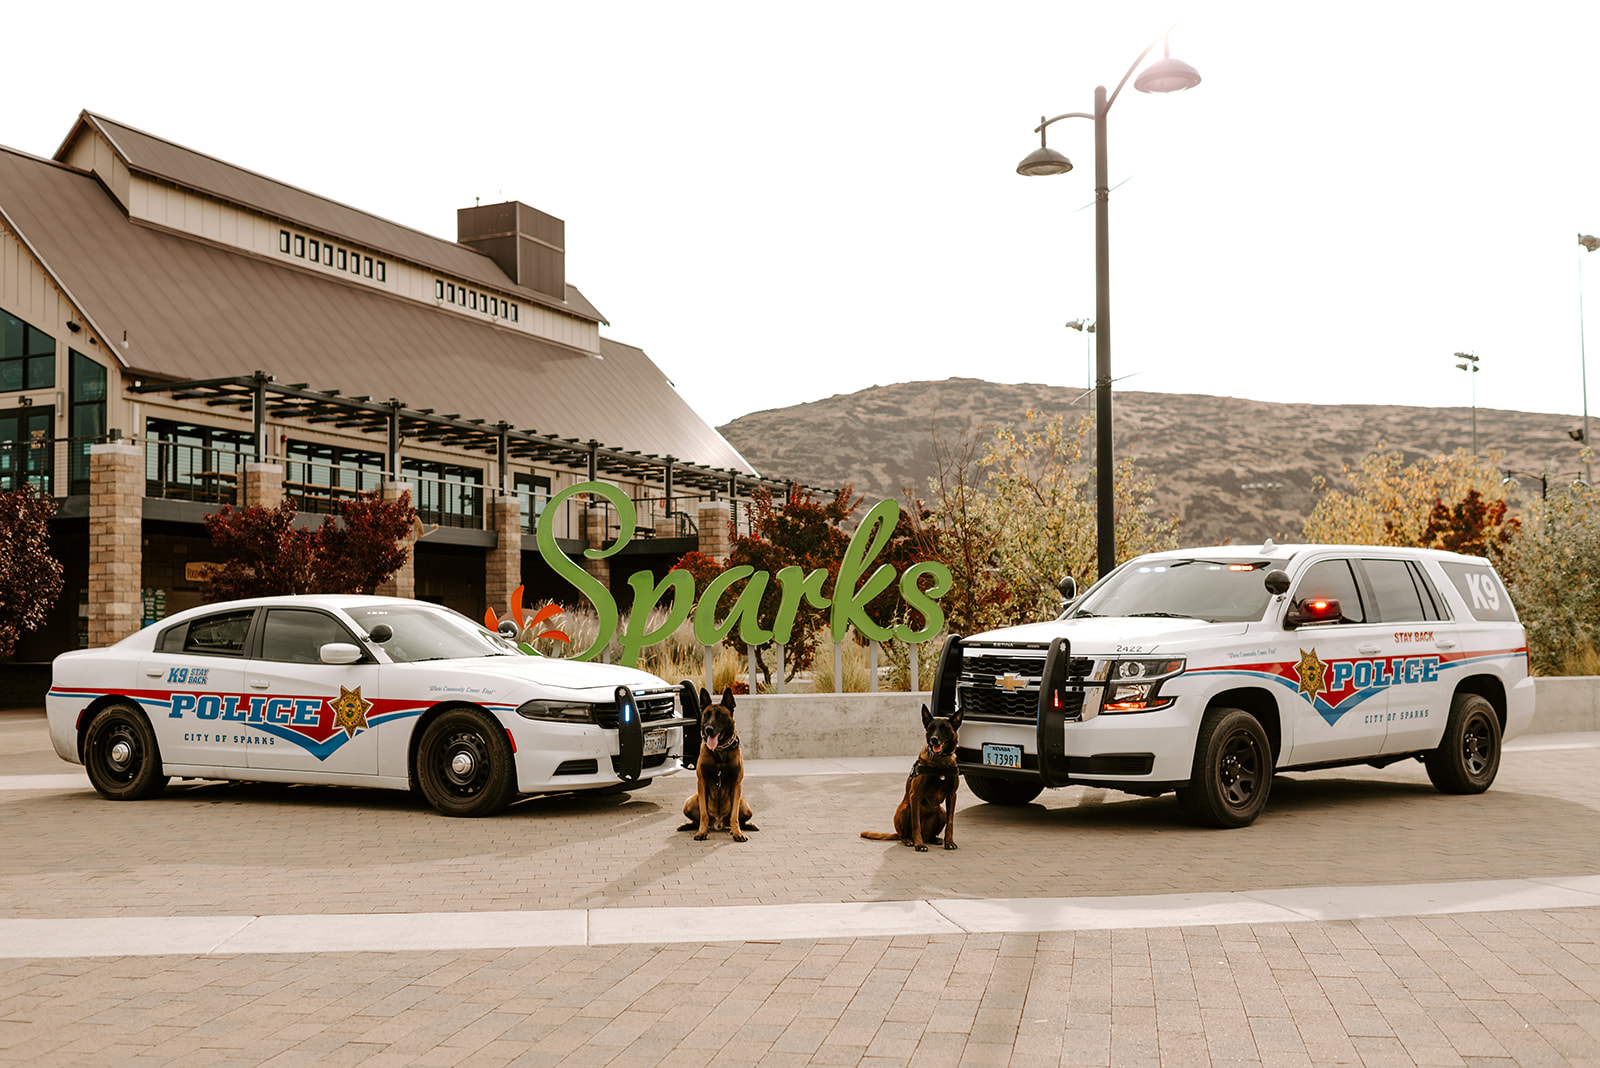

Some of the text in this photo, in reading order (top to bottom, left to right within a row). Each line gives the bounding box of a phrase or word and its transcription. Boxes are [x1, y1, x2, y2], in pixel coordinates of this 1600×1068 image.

[518, 481, 953, 668] Sparks
[1464, 573, 1500, 611] K9
[1394, 631, 1434, 643] STAY BACK
[1116, 644, 1143, 653] 2422
[167, 667, 189, 685] K9
[190, 668, 209, 677] STAY
[1331, 656, 1440, 691] POLICE
[187, 676, 208, 685] BACK
[168, 693, 323, 727] POLICE
[1364, 709, 1429, 724] CITY OF SPARKS
[184, 733, 275, 746] CITY OF SPARKS
[994, 753, 1019, 767] 73987
